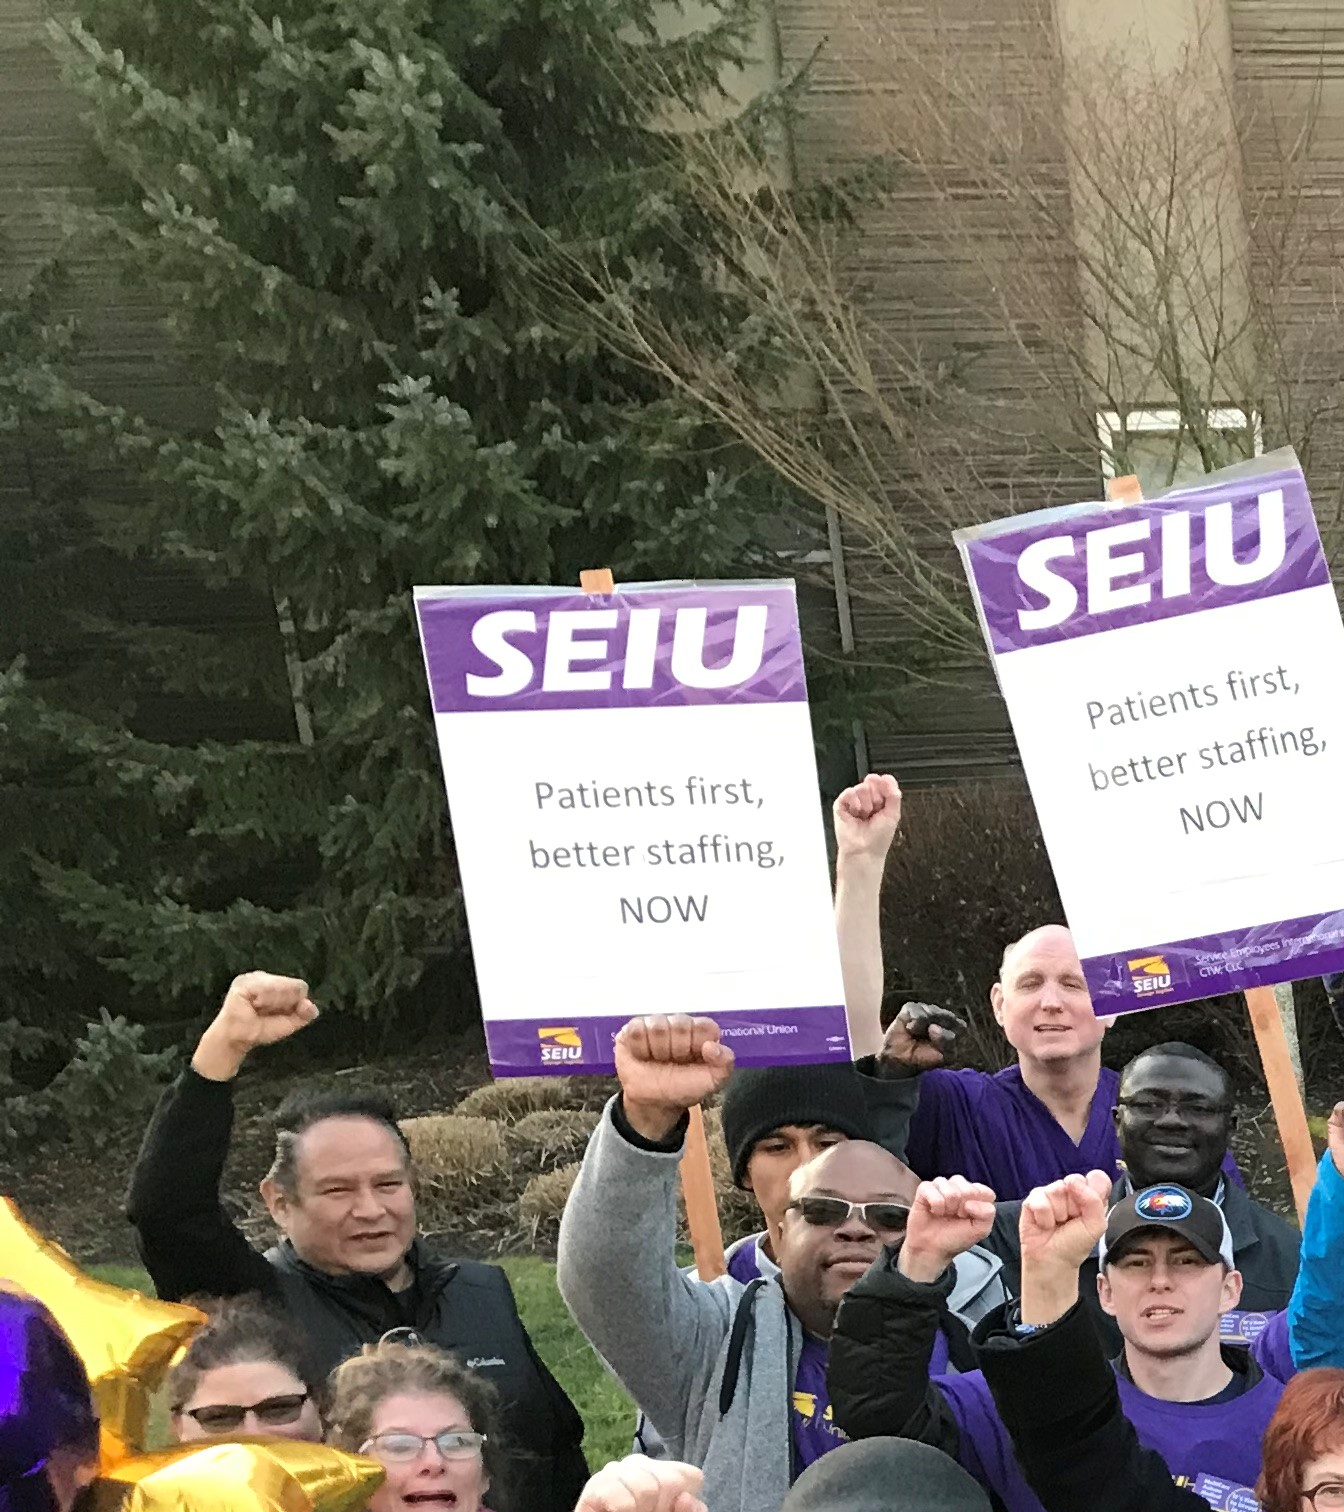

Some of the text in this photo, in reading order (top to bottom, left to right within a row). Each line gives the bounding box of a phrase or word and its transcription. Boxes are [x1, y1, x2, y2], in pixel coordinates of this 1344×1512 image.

[1017, 489, 1286, 631] SEIU
[466, 605, 768, 697] SEIU
[1085, 665, 1300, 730] Patients first,
[1088, 726, 1327, 791] better staffing,
[534, 776, 764, 810] Patients first,
[1179, 792, 1264, 835] NOW
[529, 834, 785, 869] better staffing,
[619, 895, 709, 925] NOW
[1133, 975, 1171, 994] SEIU
[721, 1023, 799, 1037] rnational Union
[540, 1047, 583, 1062] SEIU
